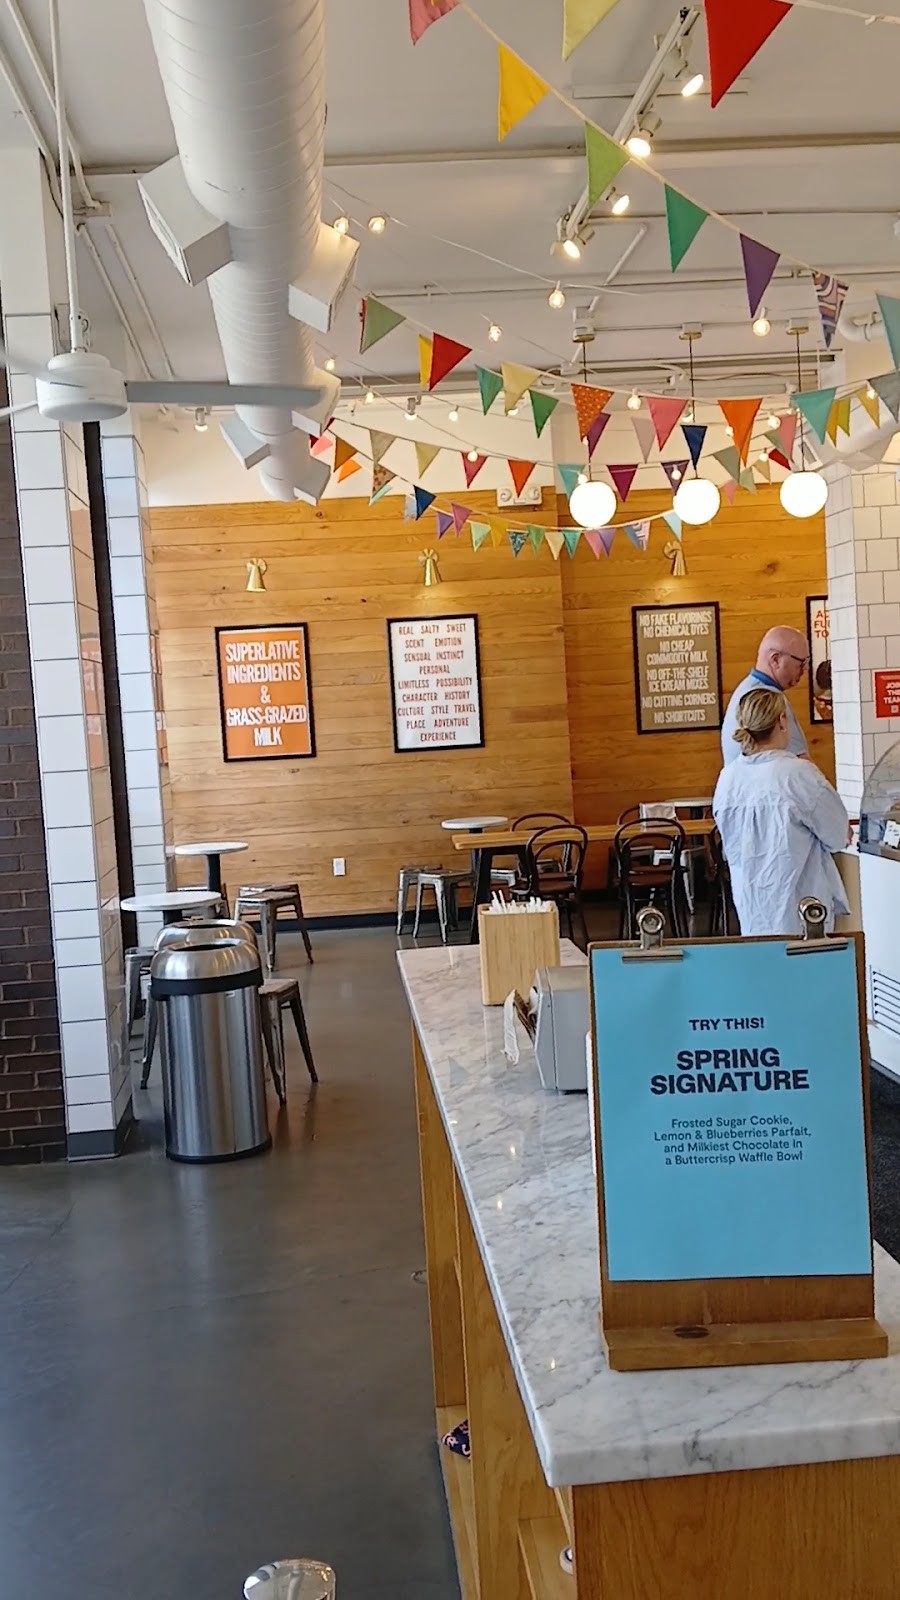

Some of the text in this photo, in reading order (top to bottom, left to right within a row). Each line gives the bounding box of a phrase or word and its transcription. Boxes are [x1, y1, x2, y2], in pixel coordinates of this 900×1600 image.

[640, 611, 712, 627] NO FAKE FLAVORINGS
[398, 623, 466, 635] REAL SALTY SWEET
[643, 623, 709, 638] NO CHEMICAL DYES
[405, 637, 461, 648] SCENT EMOTION
[660, 639, 695, 653] NO CHEAP
[225, 640, 300, 662] SUPERLATIVE
[404, 650, 464, 662] SENSUAL INSTINCT
[646, 650, 708, 666] COMMODITY MILK
[227, 662, 301, 684] INGREDIENTS
[419, 665, 450, 675] PERSONAL
[647, 669, 658, 681] NO
[398, 677, 472, 690] LIMITLESS POSSIBILITY
[648, 678, 709, 693] ICE CREAM MIXES
[260, 685, 272, 704] &
[402, 691, 470, 703] CHARACTER HISTORY
[642, 692, 716, 708] NO CUTTING CORNERS
[226, 705, 307, 726] GRASS-GRAZED
[397, 704, 476, 716] CULTURE STYLE TRAVEL
[654, 709, 706, 724] NO SHORTCUTS
[406, 718, 469, 729] PLACE ADVENTURE
[254, 726, 283, 747] MILK
[420, 731, 456, 742] EXPERIENCE
[689, 1017, 764, 1031] TRY THIS!
[677, 1047, 780, 1070] SPRING
[650, 1069, 810, 1095] SIGNATURE
[671, 1115, 793, 1128] Frosted Sugar Cookie,
[654, 1126, 812, 1141] Lemon & Blueberries Parfait,
[664, 1144, 685, 1153] and
[688, 1142, 730, 1153] Milkiest
[732, 1139, 790, 1151] Chocolate
[674, 1154, 736, 1165] Buttercrisp
[738, 1151, 774, 1162] Waffle
[776, 1150, 803, 1161] Bowl
